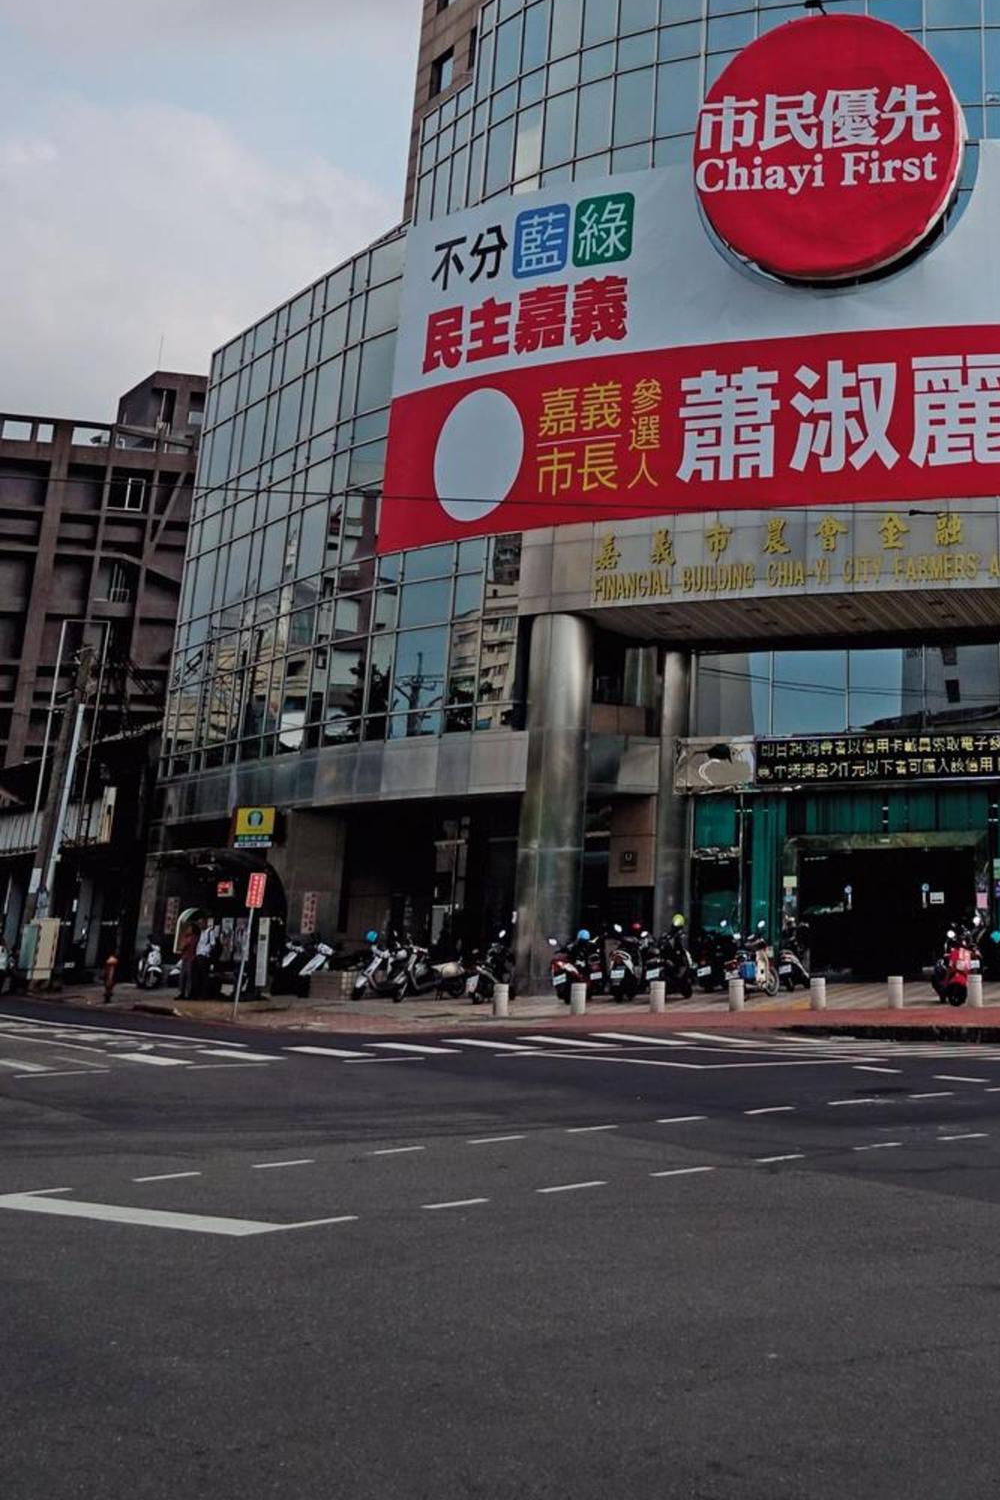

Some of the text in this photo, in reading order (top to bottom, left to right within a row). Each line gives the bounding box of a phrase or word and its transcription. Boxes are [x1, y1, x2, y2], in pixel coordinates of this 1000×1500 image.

[699, 84, 943, 154] 市民優先
[695, 151, 938, 195] Chiayi First
[431, 202, 628, 291] 不分藍綠
[422, 276, 629, 375] 民主嘉義
[537, 380, 622, 438] 嘉義
[627, 377, 664, 489] 參選人
[536, 446, 619, 496] 市長
[593, 568, 672, 601] FINANCIAL
[682, 562, 755, 593] BUILDING
[767, 558, 831, 588] CHIA-YI
[843, 554, 882, 584] CITY
